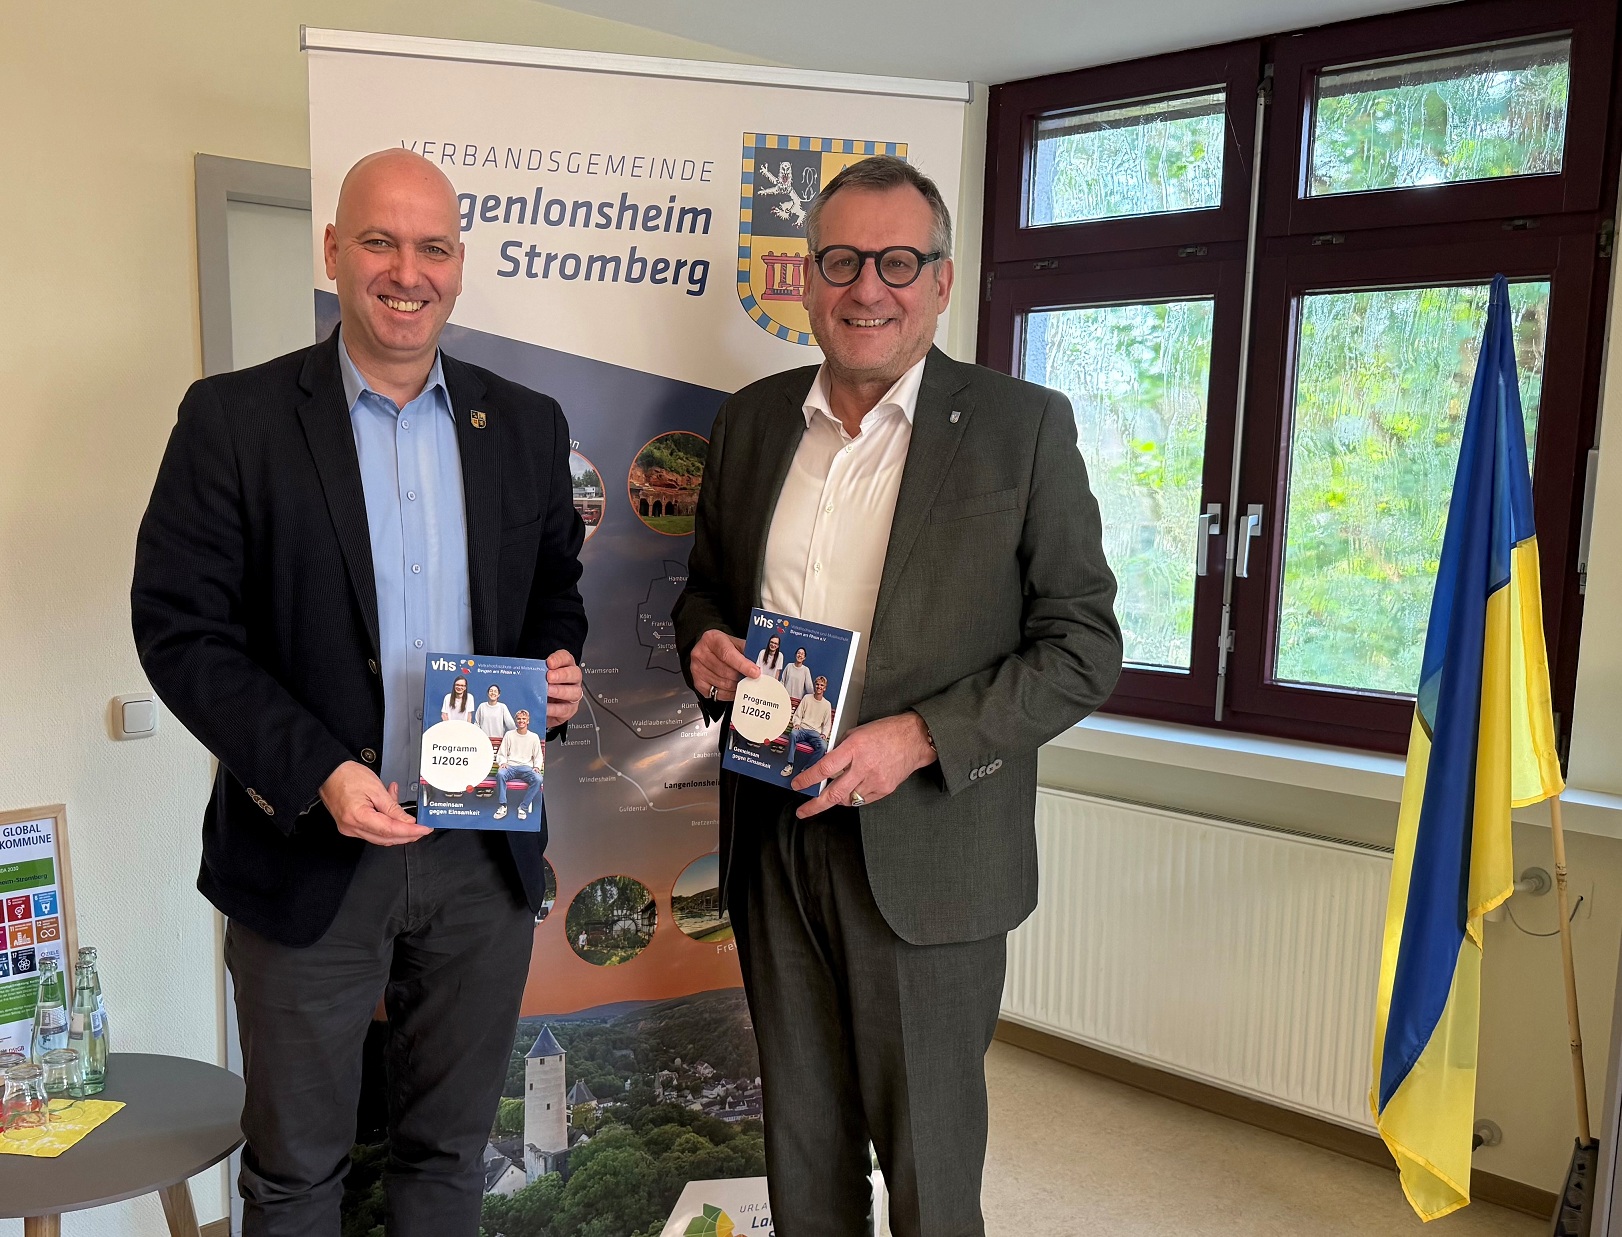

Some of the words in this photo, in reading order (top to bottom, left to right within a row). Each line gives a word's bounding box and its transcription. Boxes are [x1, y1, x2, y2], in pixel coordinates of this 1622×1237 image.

[497, 240, 709, 296] Stromberg
[753, 614, 774, 629] vhs
[431, 657, 457, 672] vhs
[743, 694, 779, 709] Programm
[741, 705, 771, 720] 1/2026
[631, 718, 683, 727] Waldlaubersheim
[432, 744, 478, 753] Programm
[733, 746, 759, 758] Gemeinsam
[432, 756, 469, 766] 1/2026
[578, 775, 617, 783] Windesheim
[619, 805, 648, 813] Guldental
[3, 824, 41, 837] GLOBAL
[0, 833, 52, 850] KOMMUNE
